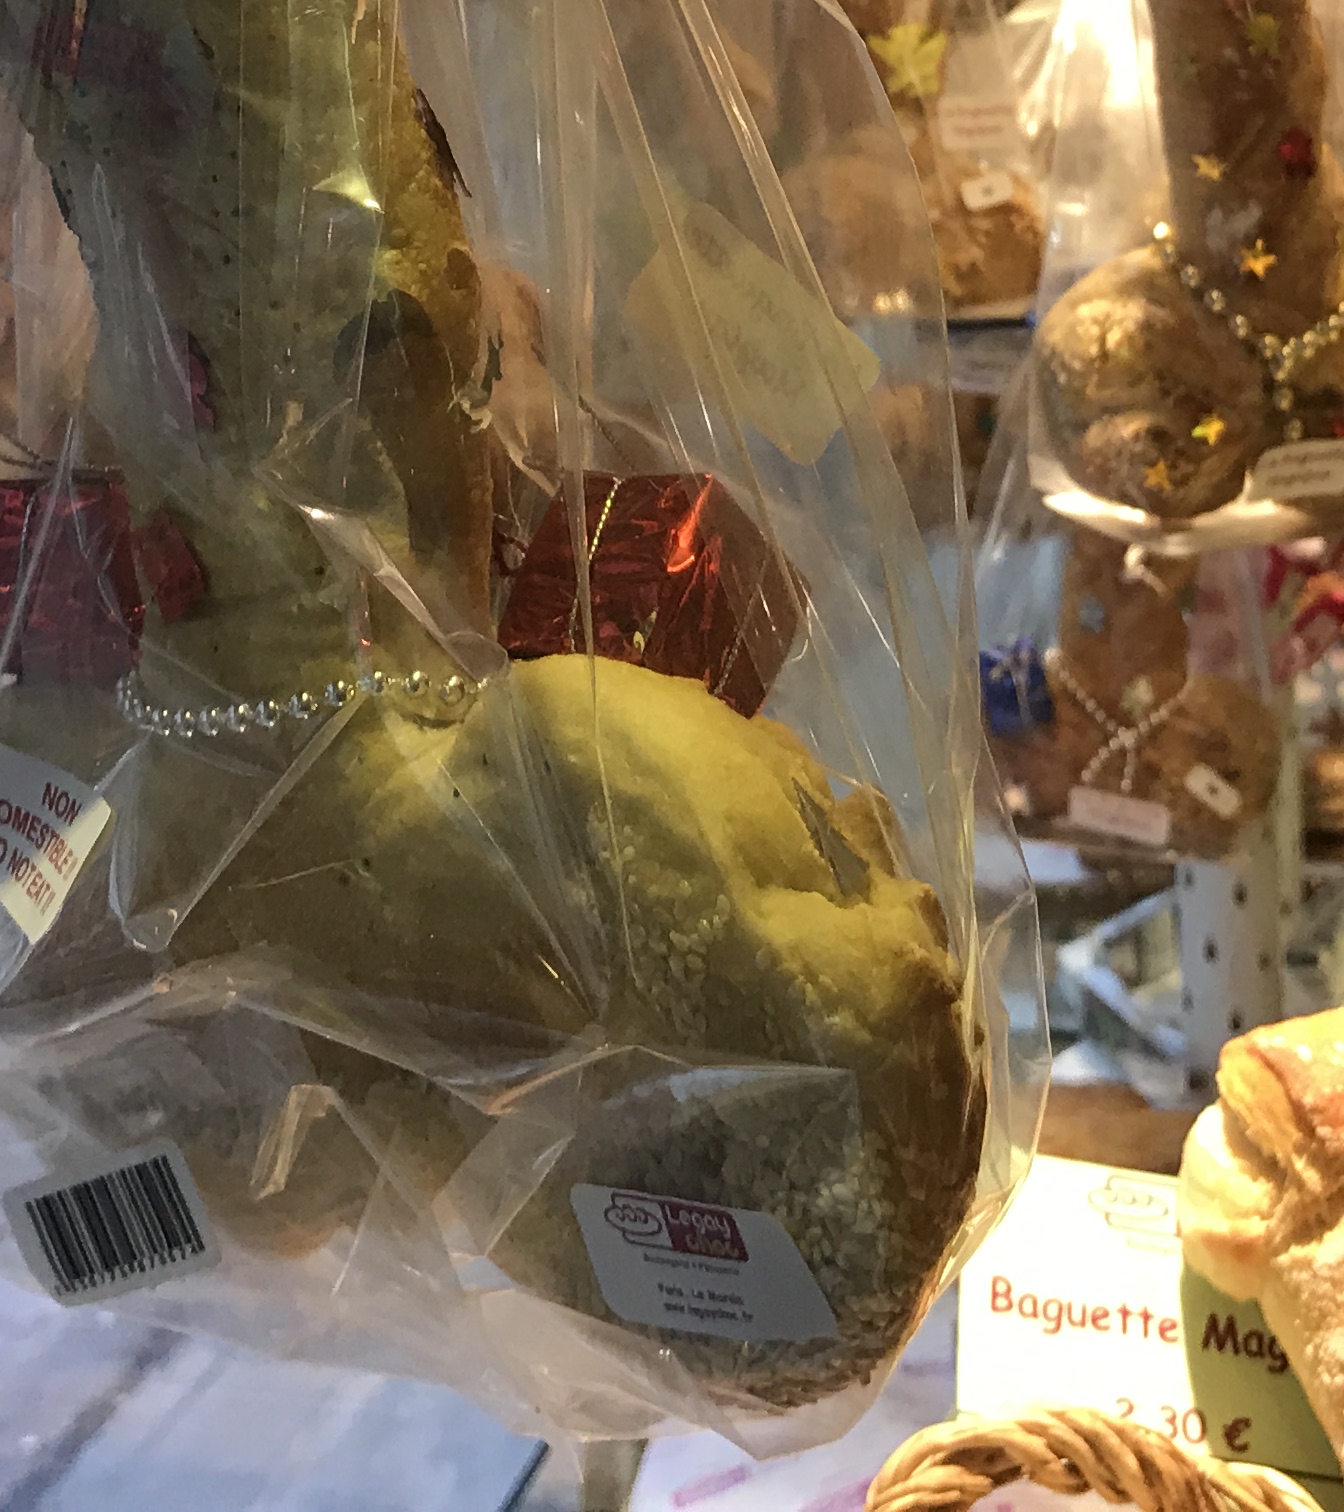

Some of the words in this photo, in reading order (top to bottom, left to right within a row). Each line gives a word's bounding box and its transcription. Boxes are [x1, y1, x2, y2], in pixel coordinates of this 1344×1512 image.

[41, 781, 83, 827] NON
[7, 846, 37, 888] NOT
[991, 1275, 1179, 1343] Baguette
[1222, 1416, 1253, 1454] €
